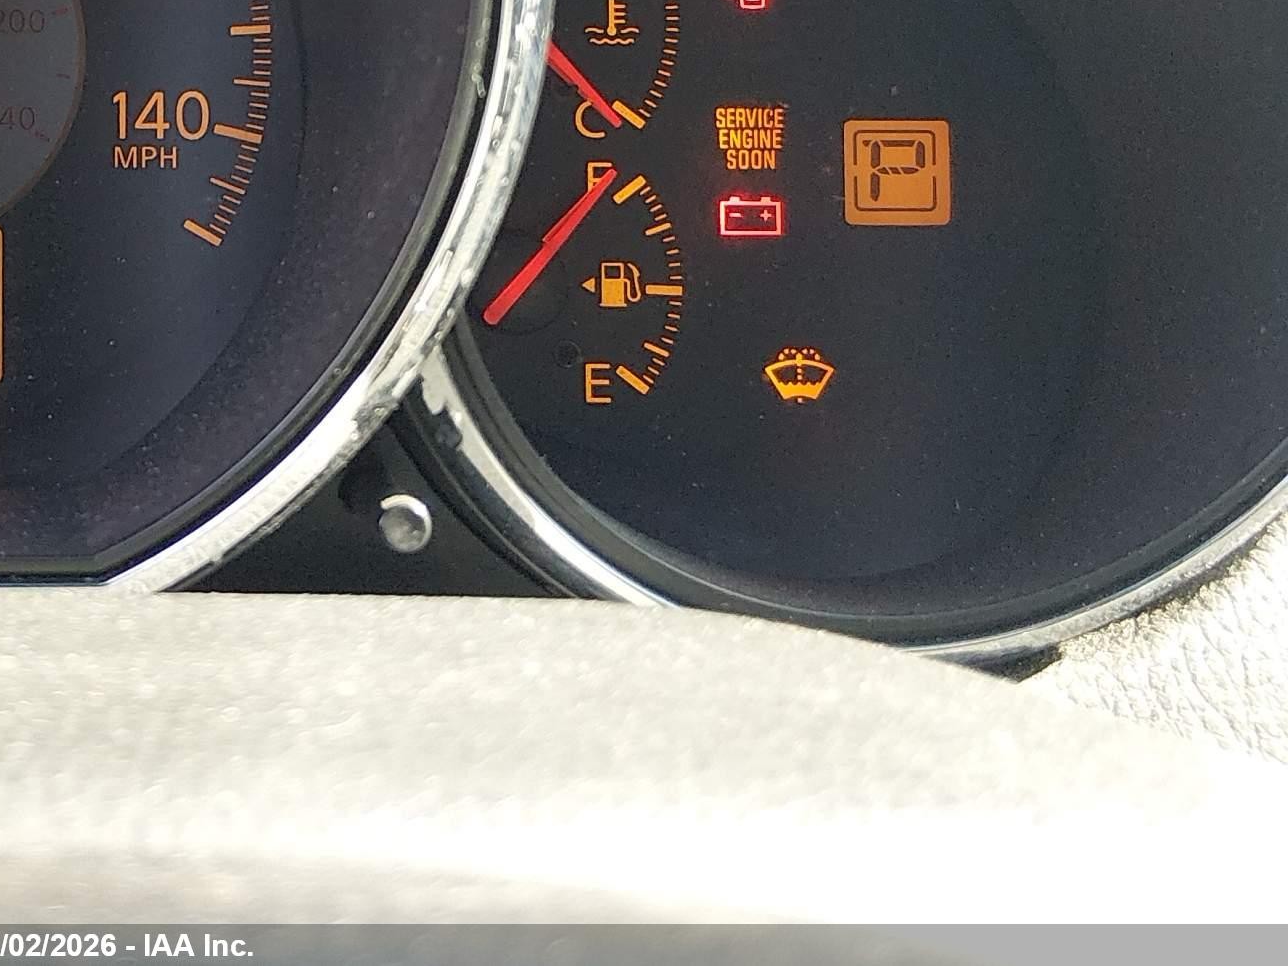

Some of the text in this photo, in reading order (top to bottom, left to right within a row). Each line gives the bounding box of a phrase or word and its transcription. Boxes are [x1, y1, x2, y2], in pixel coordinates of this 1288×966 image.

[112, 89, 210, 140] 140
[575, 99, 606, 138] C
[715, 107, 784, 128] SERVICE
[718, 129, 783, 149] ENGINE
[114, 146, 178, 167] MPH
[726, 149, 776, 170] SOON
[862, 139, 926, 202] P
[587, 162, 613, 195] F
[585, 363, 612, 403] E
